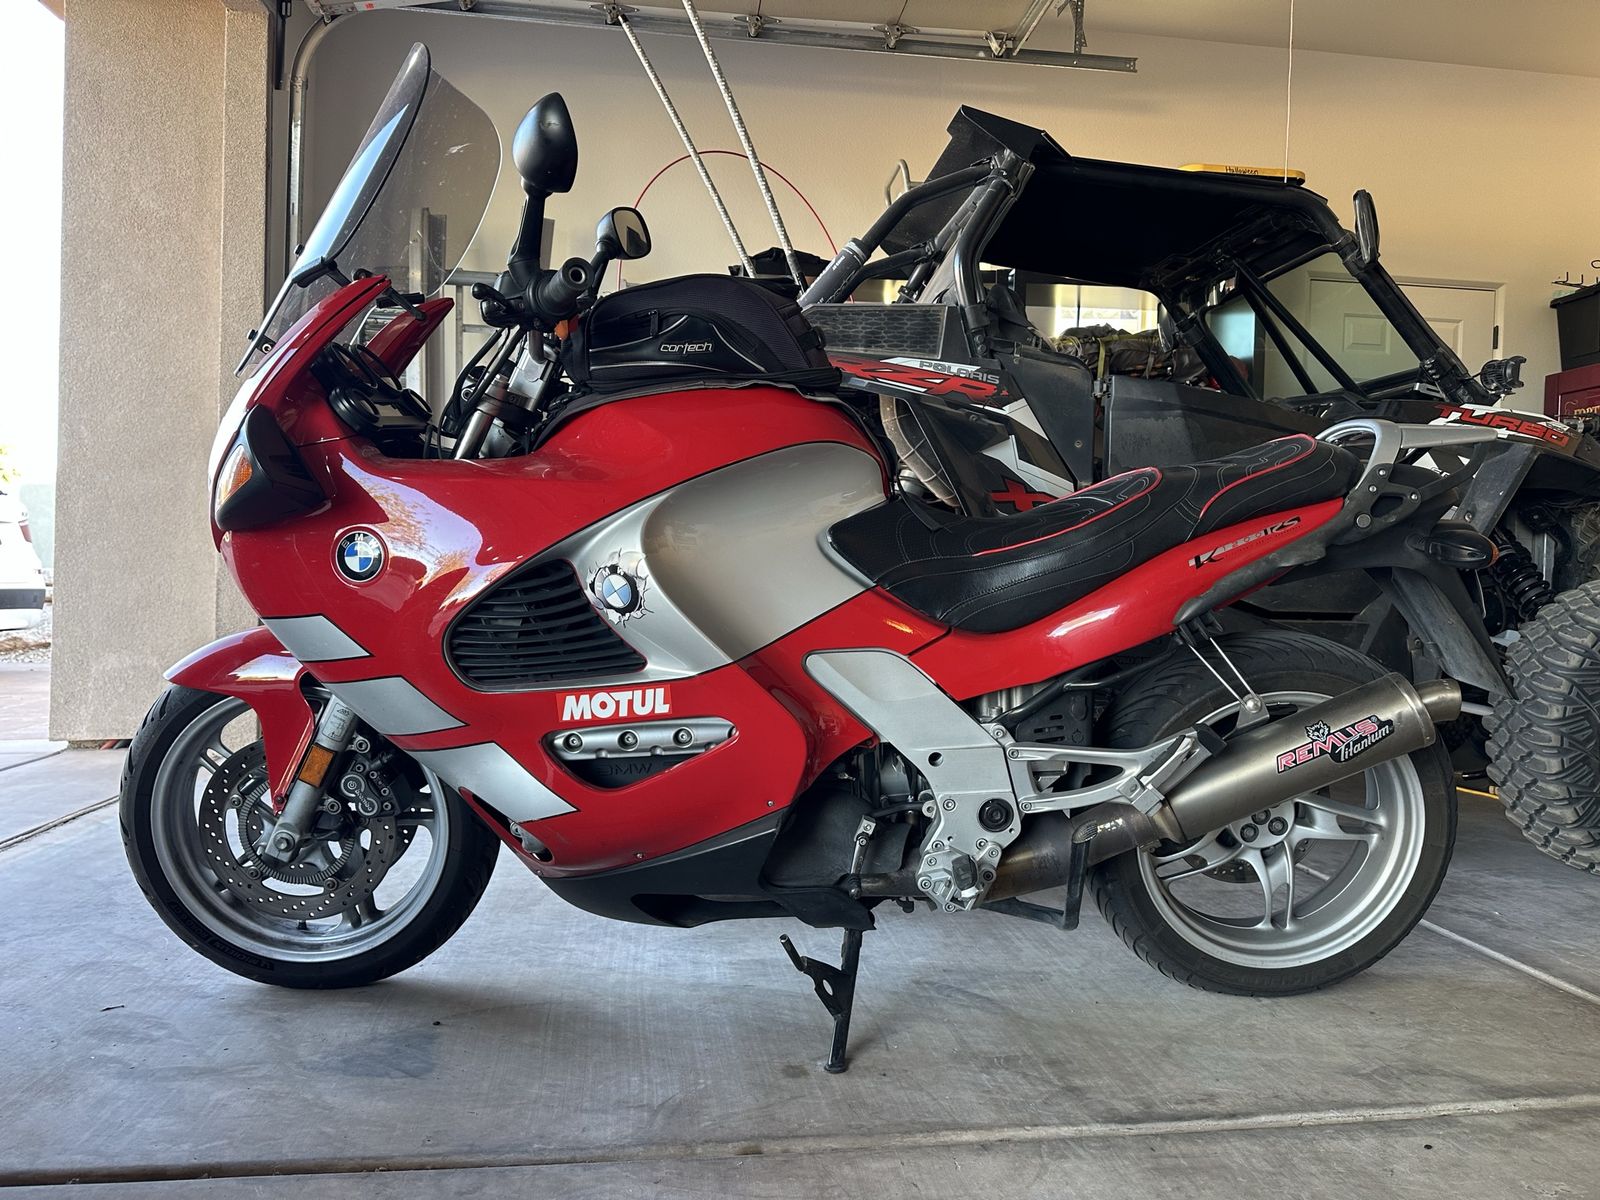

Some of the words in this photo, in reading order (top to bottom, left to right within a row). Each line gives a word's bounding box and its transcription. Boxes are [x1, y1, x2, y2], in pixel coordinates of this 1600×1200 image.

[660, 342, 713, 355] cortech
[918, 360, 1000, 385] POLARIS
[1435, 403, 1570, 447] TURBO
[562, 687, 671, 722] MOTUL
[1277, 718, 1379, 772] REMUS
[1335, 724, 1391, 762] Titanium
